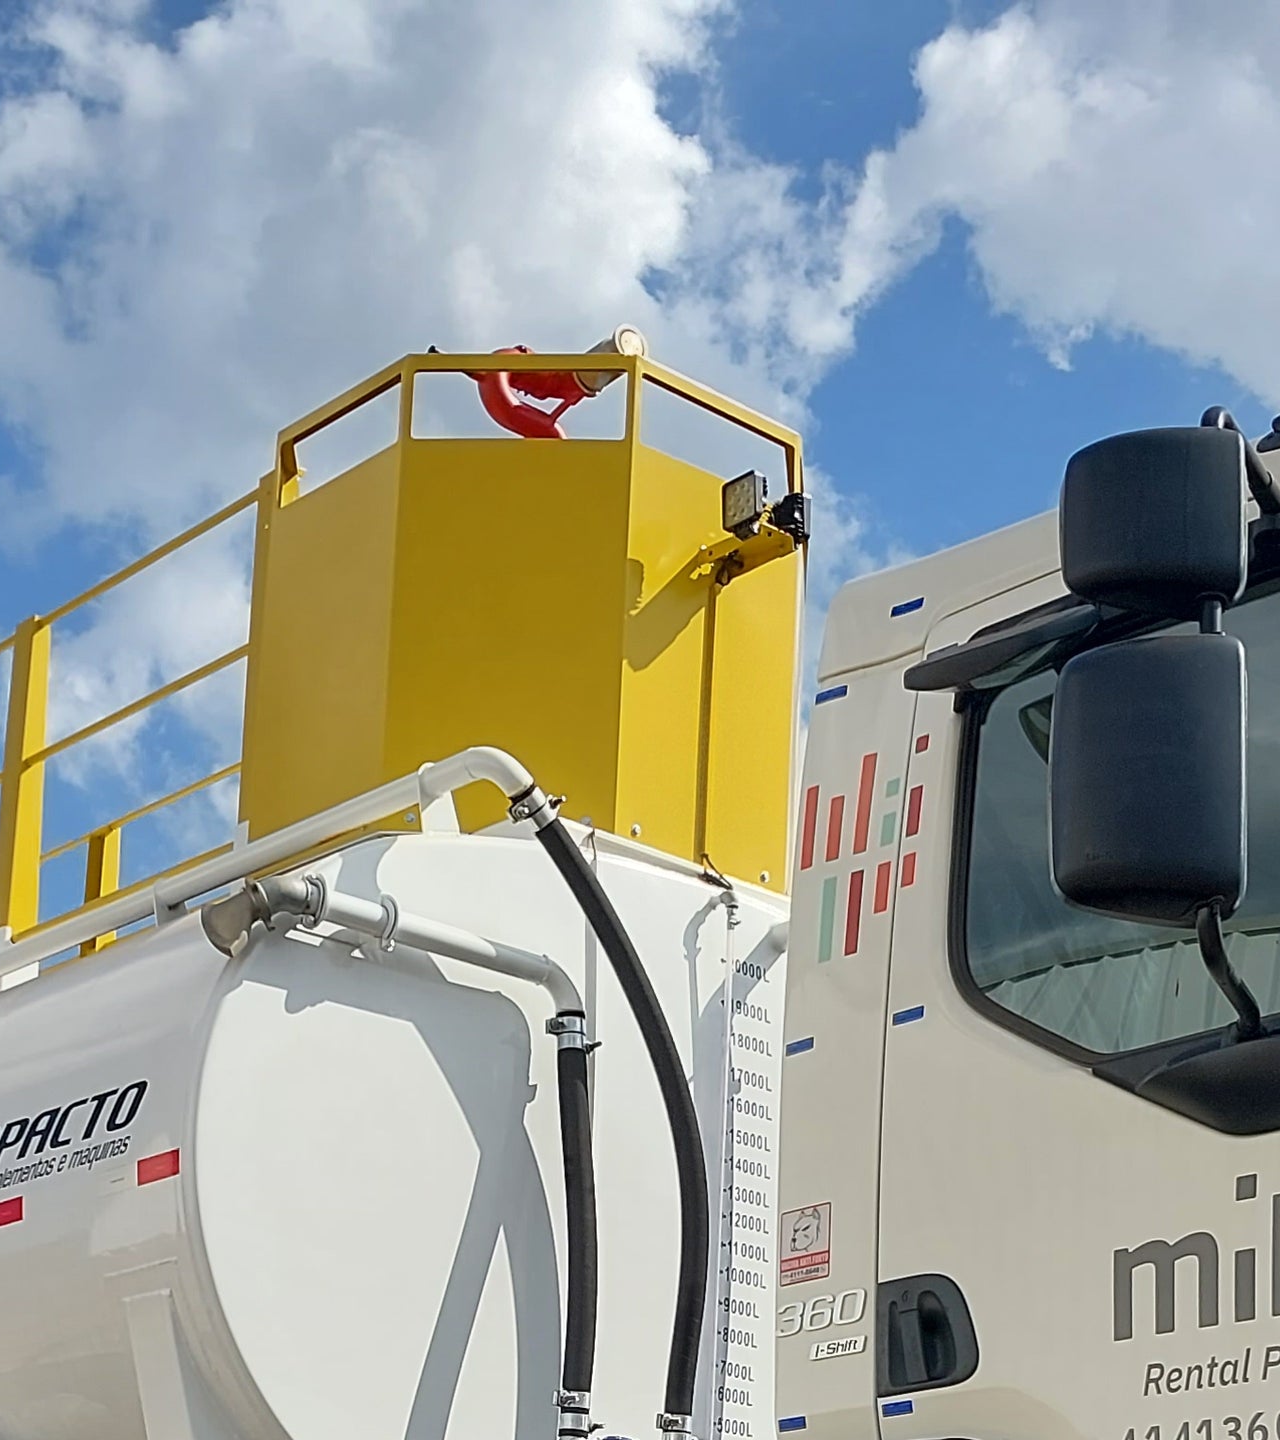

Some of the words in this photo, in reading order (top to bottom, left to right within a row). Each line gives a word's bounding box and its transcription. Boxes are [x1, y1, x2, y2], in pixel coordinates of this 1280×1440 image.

[732, 959, 770, 984] 0000L
[731, 998, 771, 1024] 19000L
[730, 1032, 773, 1057] 18000L
[730, 1067, 772, 1092] 17000L
[730, 1096, 772, 1121] 16000L
[728, 1129, 771, 1152] 15000L
[56, 1154, 68, 1173] e
[728, 1157, 771, 1180] 14000L
[728, 1185, 770, 1209] 13000L
[729, 1211, 769, 1235] 12000L
[726, 1241, 769, 1263] 11000L
[724, 1267, 767, 1289] 10000L
[721, 1298, 760, 1319] 9000L
[775, 1287, 867, 1338] 360
[720, 1328, 758, 1349] 8000L
[814, 1338, 859, 1358] I-Shift
[719, 1359, 755, 1382] 7000L
[1143, 1348, 1251, 1397] Rental
[718, 1386, 753, 1407] 6000L
[716, 1417, 754, 1438] 5000L
